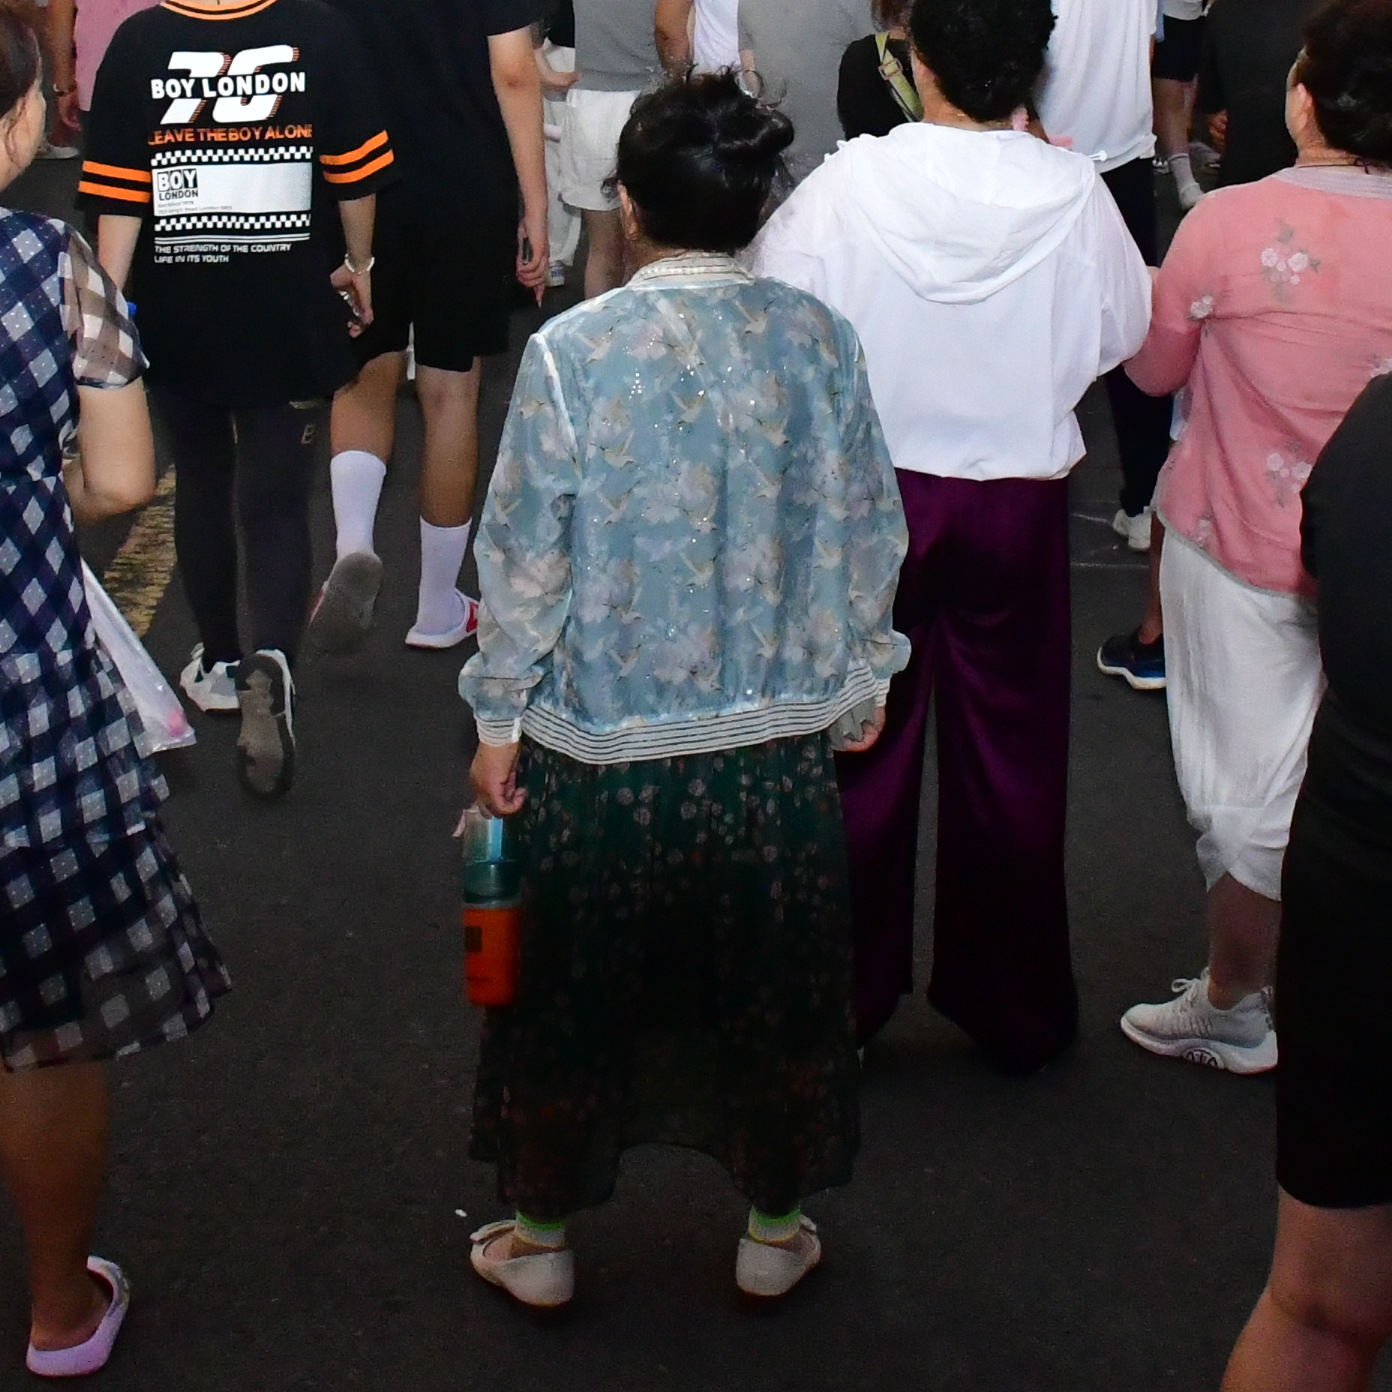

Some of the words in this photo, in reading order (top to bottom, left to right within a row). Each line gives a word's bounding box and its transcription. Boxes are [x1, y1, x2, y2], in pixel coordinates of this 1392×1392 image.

[150, 78, 196, 99] BOY
[201, 71, 306, 98] LONDON
[264, 124, 313, 140] ALONE
[158, 168, 199, 192] BOY
[159, 189, 199, 201] LONDON
[154, 245, 171, 254] THE
[173, 244, 219, 254] STRENGTH
[233, 244, 249, 253] THE
[250, 243, 292, 253] COUNTRY
[202, 255, 230, 263] YOUTH
